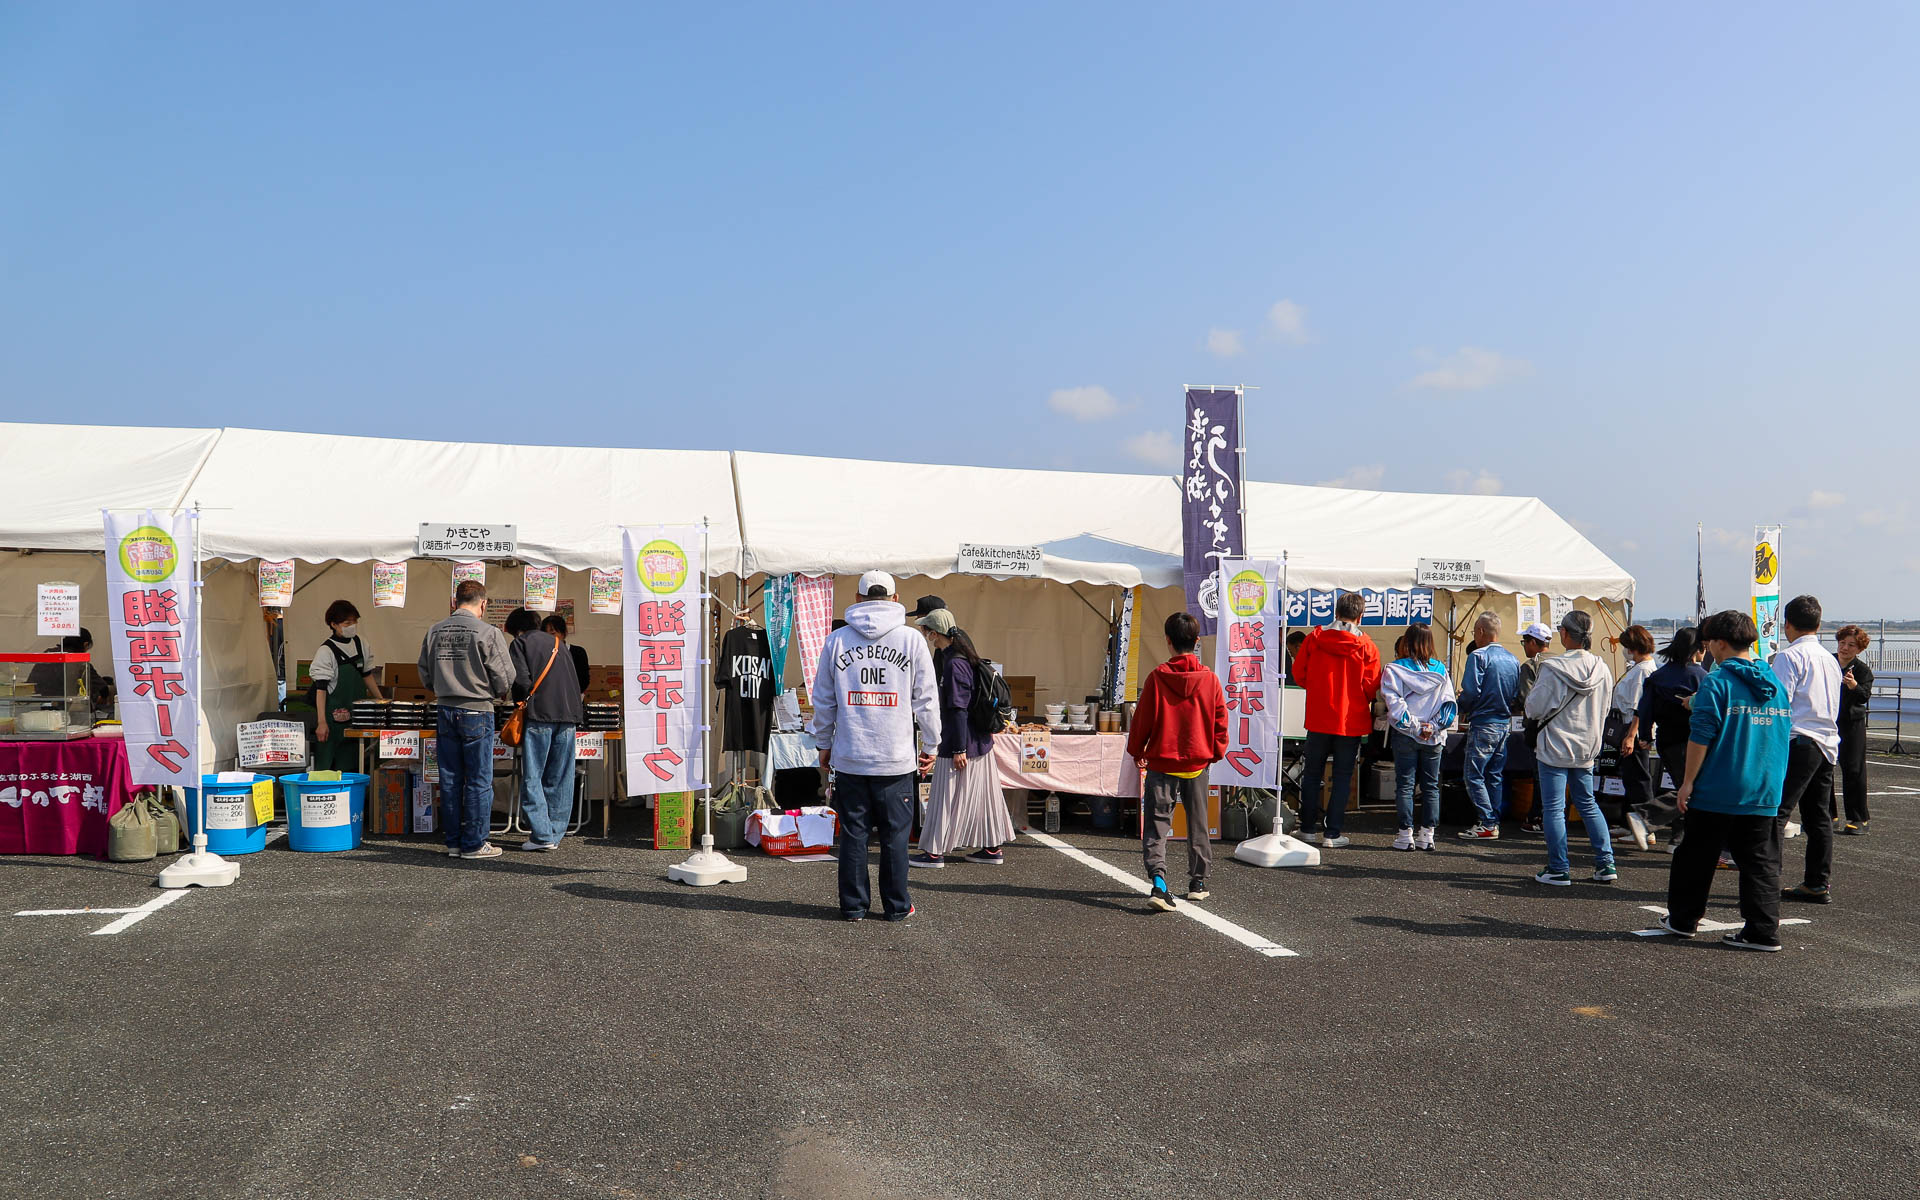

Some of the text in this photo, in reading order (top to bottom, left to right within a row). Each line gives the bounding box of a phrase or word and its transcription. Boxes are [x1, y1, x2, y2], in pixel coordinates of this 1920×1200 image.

[446, 527, 490, 538] かきこや
[422, 540, 514, 552] (湖西ポークの巻き寿司)
[971, 560, 1030, 571] (湖西ポーク丼)
[1432, 562, 1472, 572] マルマ養魚
[1421, 572, 1482, 582] (浜名湖うなぎ弁当)
[835, 645, 911, 672] LET'S BECOME
[732, 655, 771, 680] KOSAI
[861, 667, 886, 685] ONE
[740, 674, 762, 699] CITY
[849, 692, 897, 706] KOSAICITY
